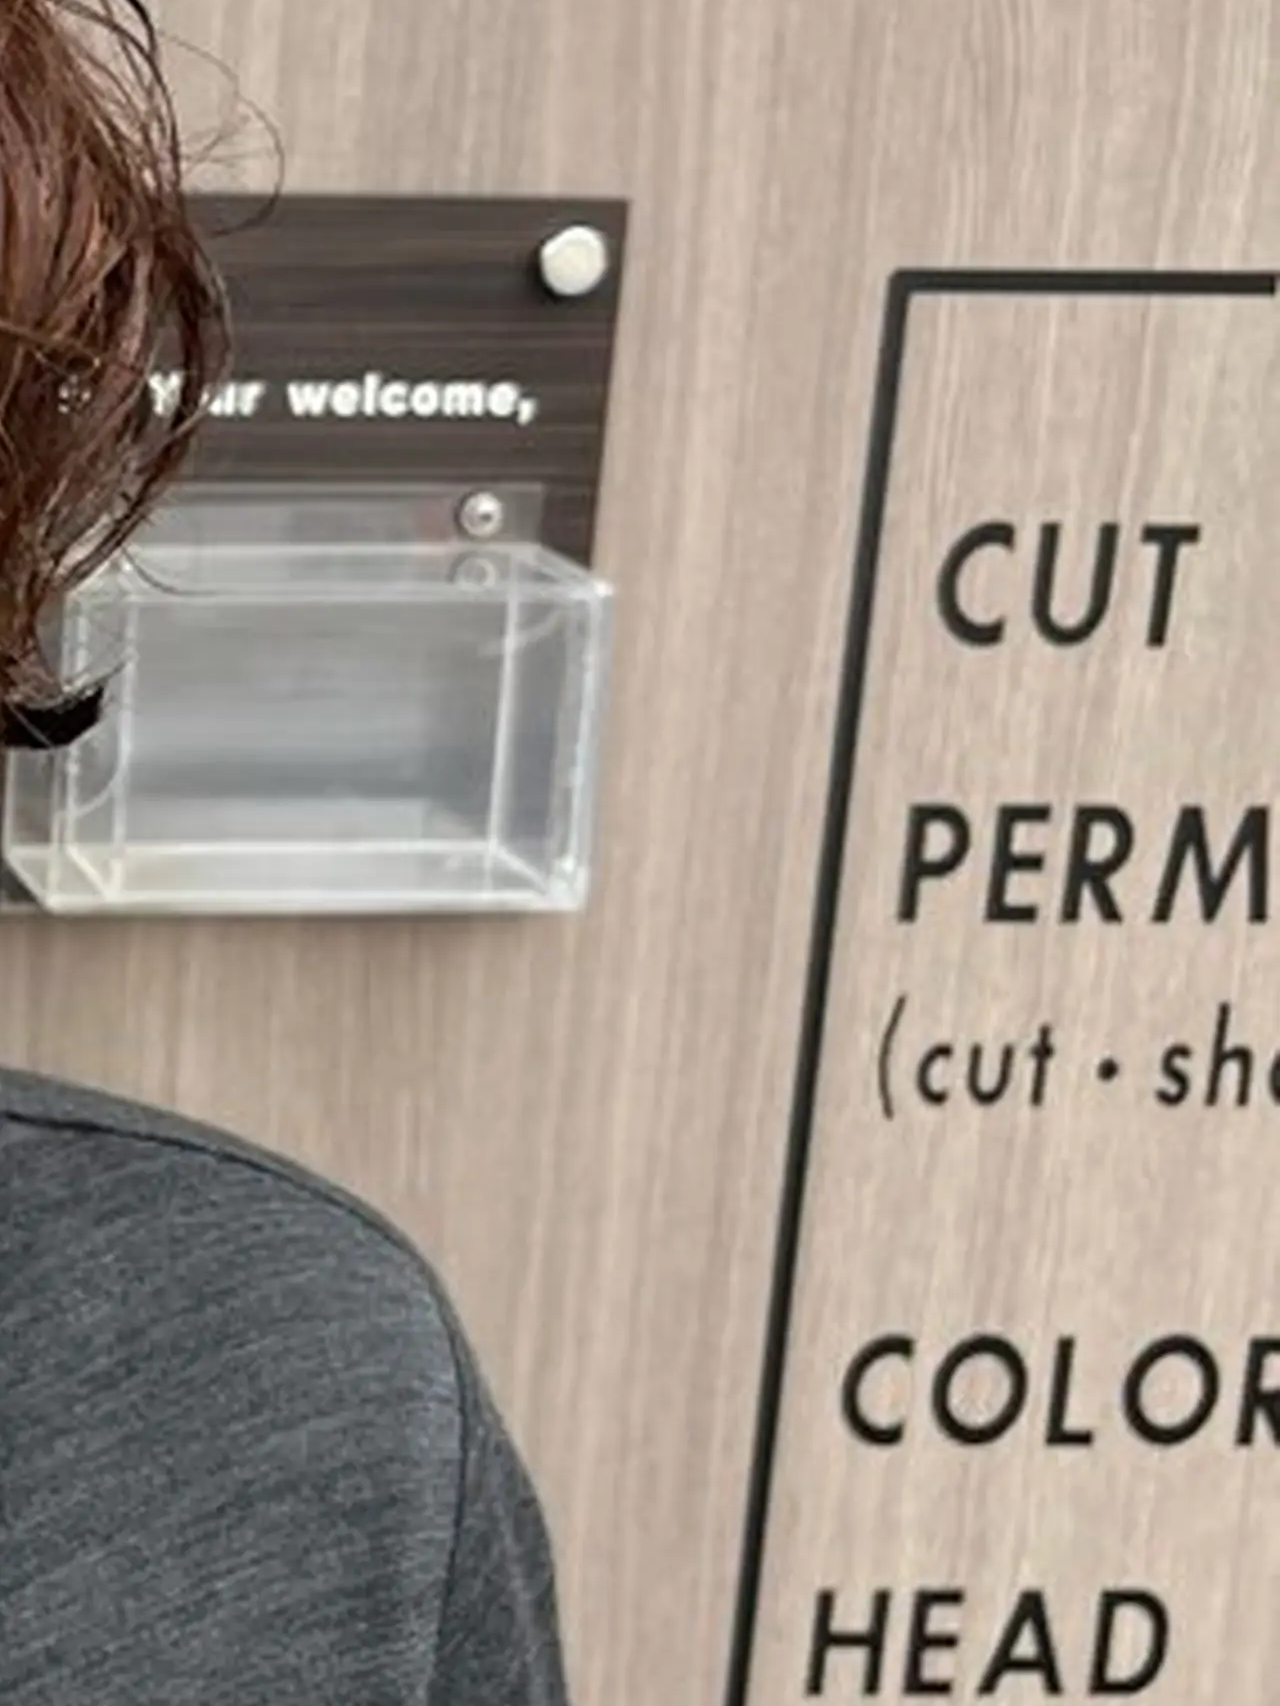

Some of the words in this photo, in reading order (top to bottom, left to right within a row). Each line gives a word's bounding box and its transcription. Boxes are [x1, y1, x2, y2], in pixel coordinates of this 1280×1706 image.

[286, 372, 537, 425] welcome,
[937, 521, 1202, 649] CUT
[896, 803, 1272, 925] PERM
[1154, 1000, 1280, 1109] sh
[840, 1332, 1280, 1448] COLOR
[804, 1587, 1170, 1698] HEAD
